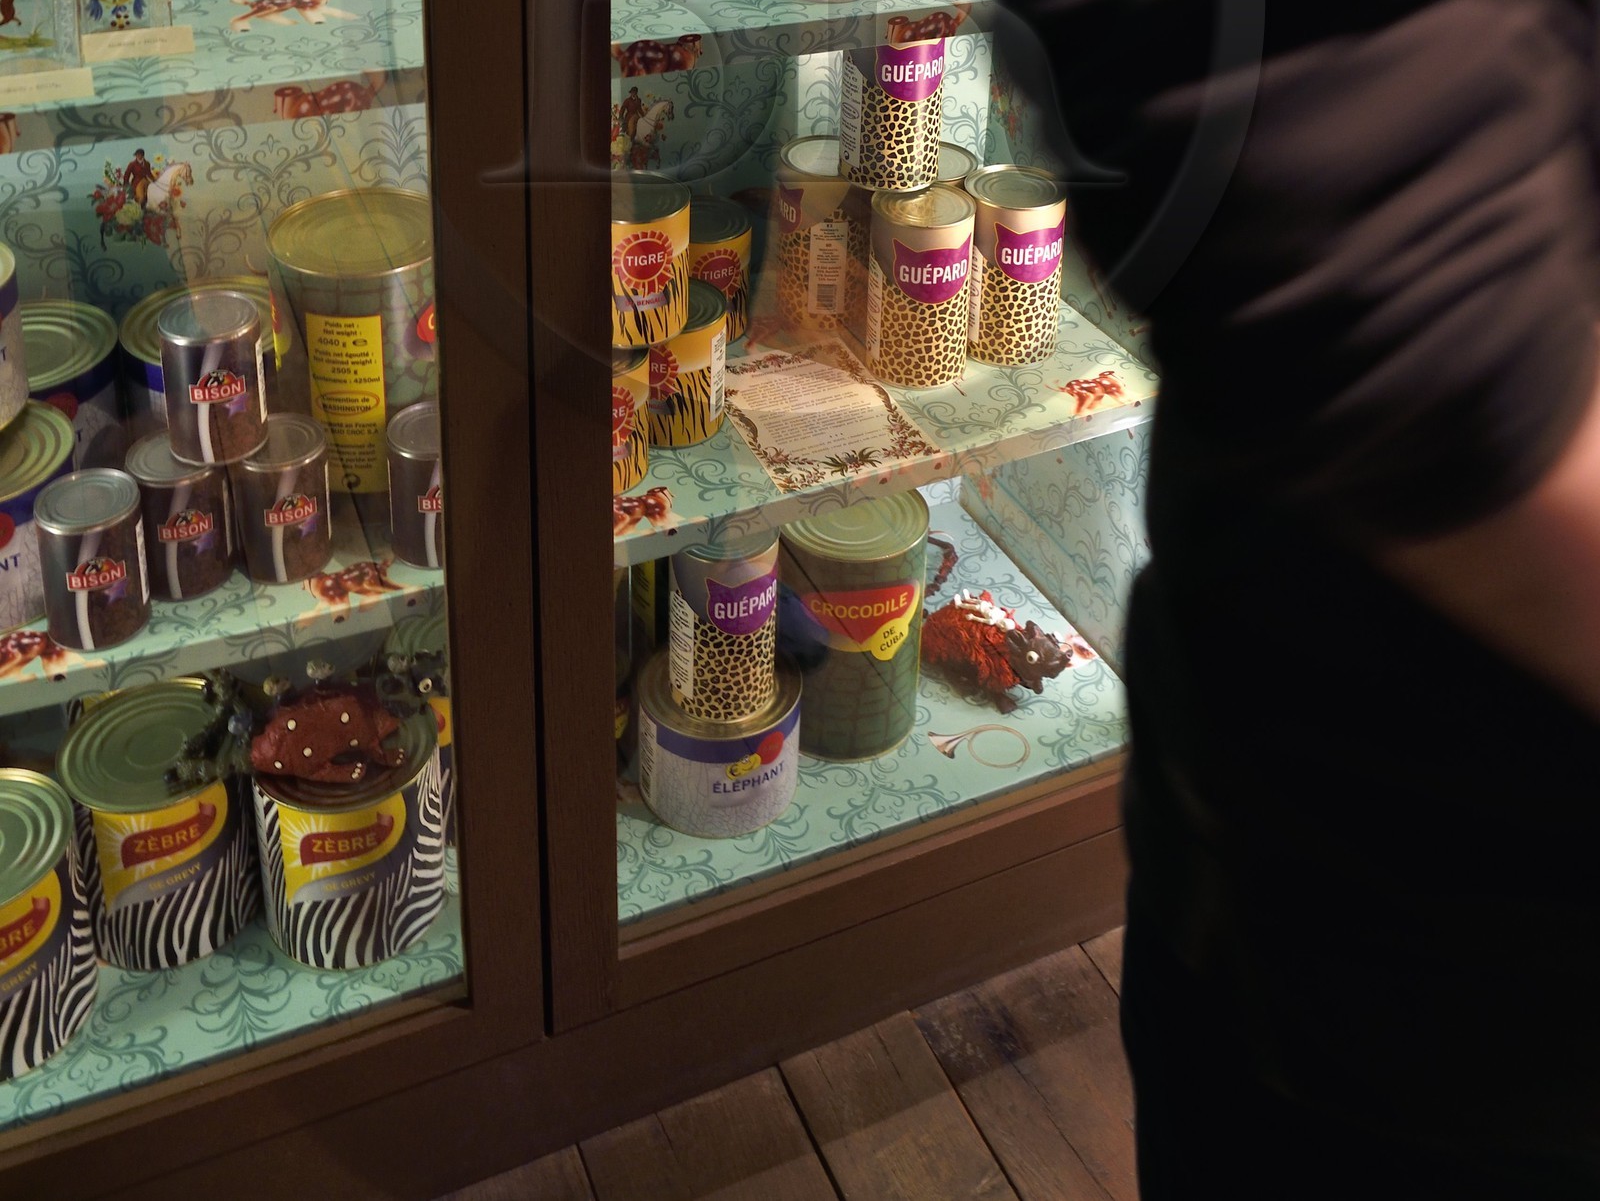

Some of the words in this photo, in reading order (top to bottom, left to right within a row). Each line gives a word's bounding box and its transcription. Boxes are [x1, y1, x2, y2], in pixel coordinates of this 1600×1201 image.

[881, 56, 943, 83] GUÉPARD
[626, 252, 665, 267] TIGRE
[1001, 237, 1063, 266] GUÉPARD
[702, 266, 735, 280] TIGRE
[899, 259, 968, 285] GUÉPARD
[194, 381, 241, 401] BISON
[269, 502, 313, 523] BISON
[162, 519, 208, 539] BISON
[71, 567, 121, 588] BISON
[714, 578, 777, 620] GUÉPARD
[810, 591, 909, 619] CROCODILE
[880, 632, 904, 652] CUBA
[882, 626, 896, 639] DE
[712, 761, 785, 794] ÉLÉPHANT
[133, 823, 202, 853] ZÈBRE
[312, 832, 378, 854] ZÈBRE
[0, 919, 36, 951] BRE
